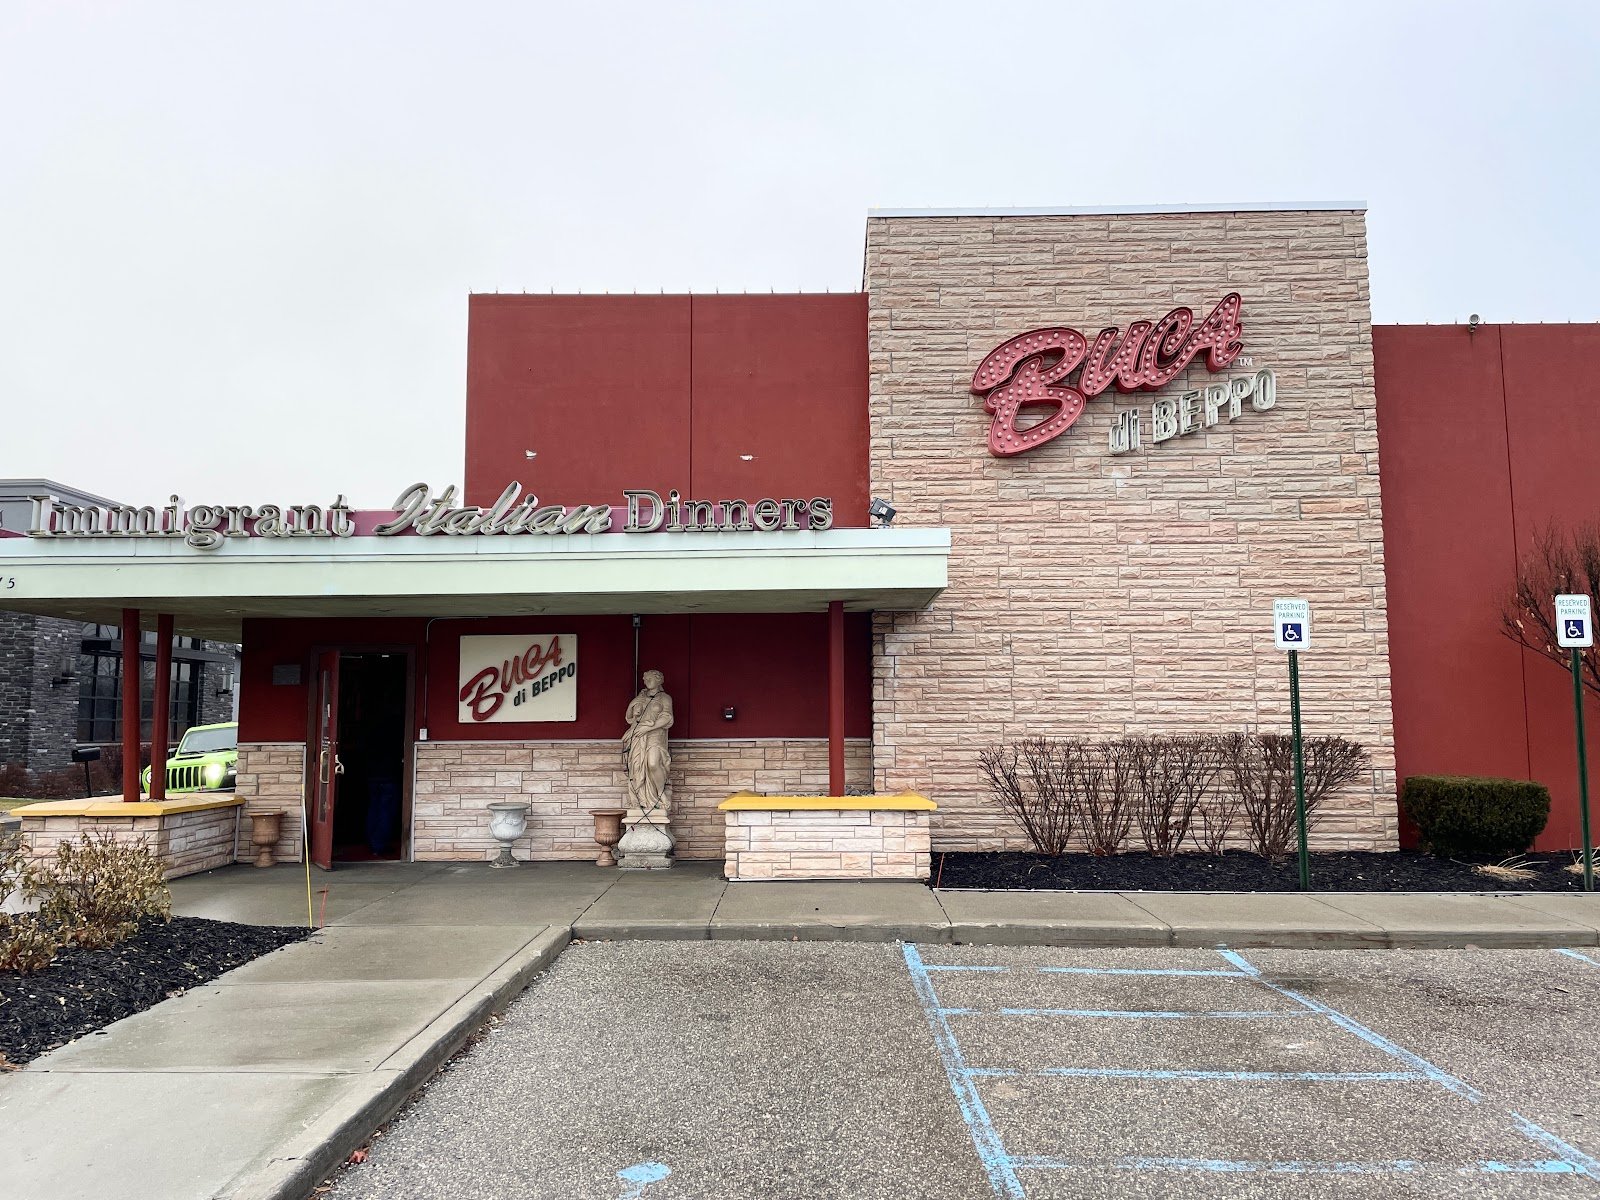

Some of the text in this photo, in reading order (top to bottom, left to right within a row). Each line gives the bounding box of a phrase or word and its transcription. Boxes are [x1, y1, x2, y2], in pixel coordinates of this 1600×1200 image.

[1108, 368, 1277, 456] di BEPPO
[27, 481, 833, 550] Immigrant Italian Dinners
[513, 662, 576, 707] di BEPPO
